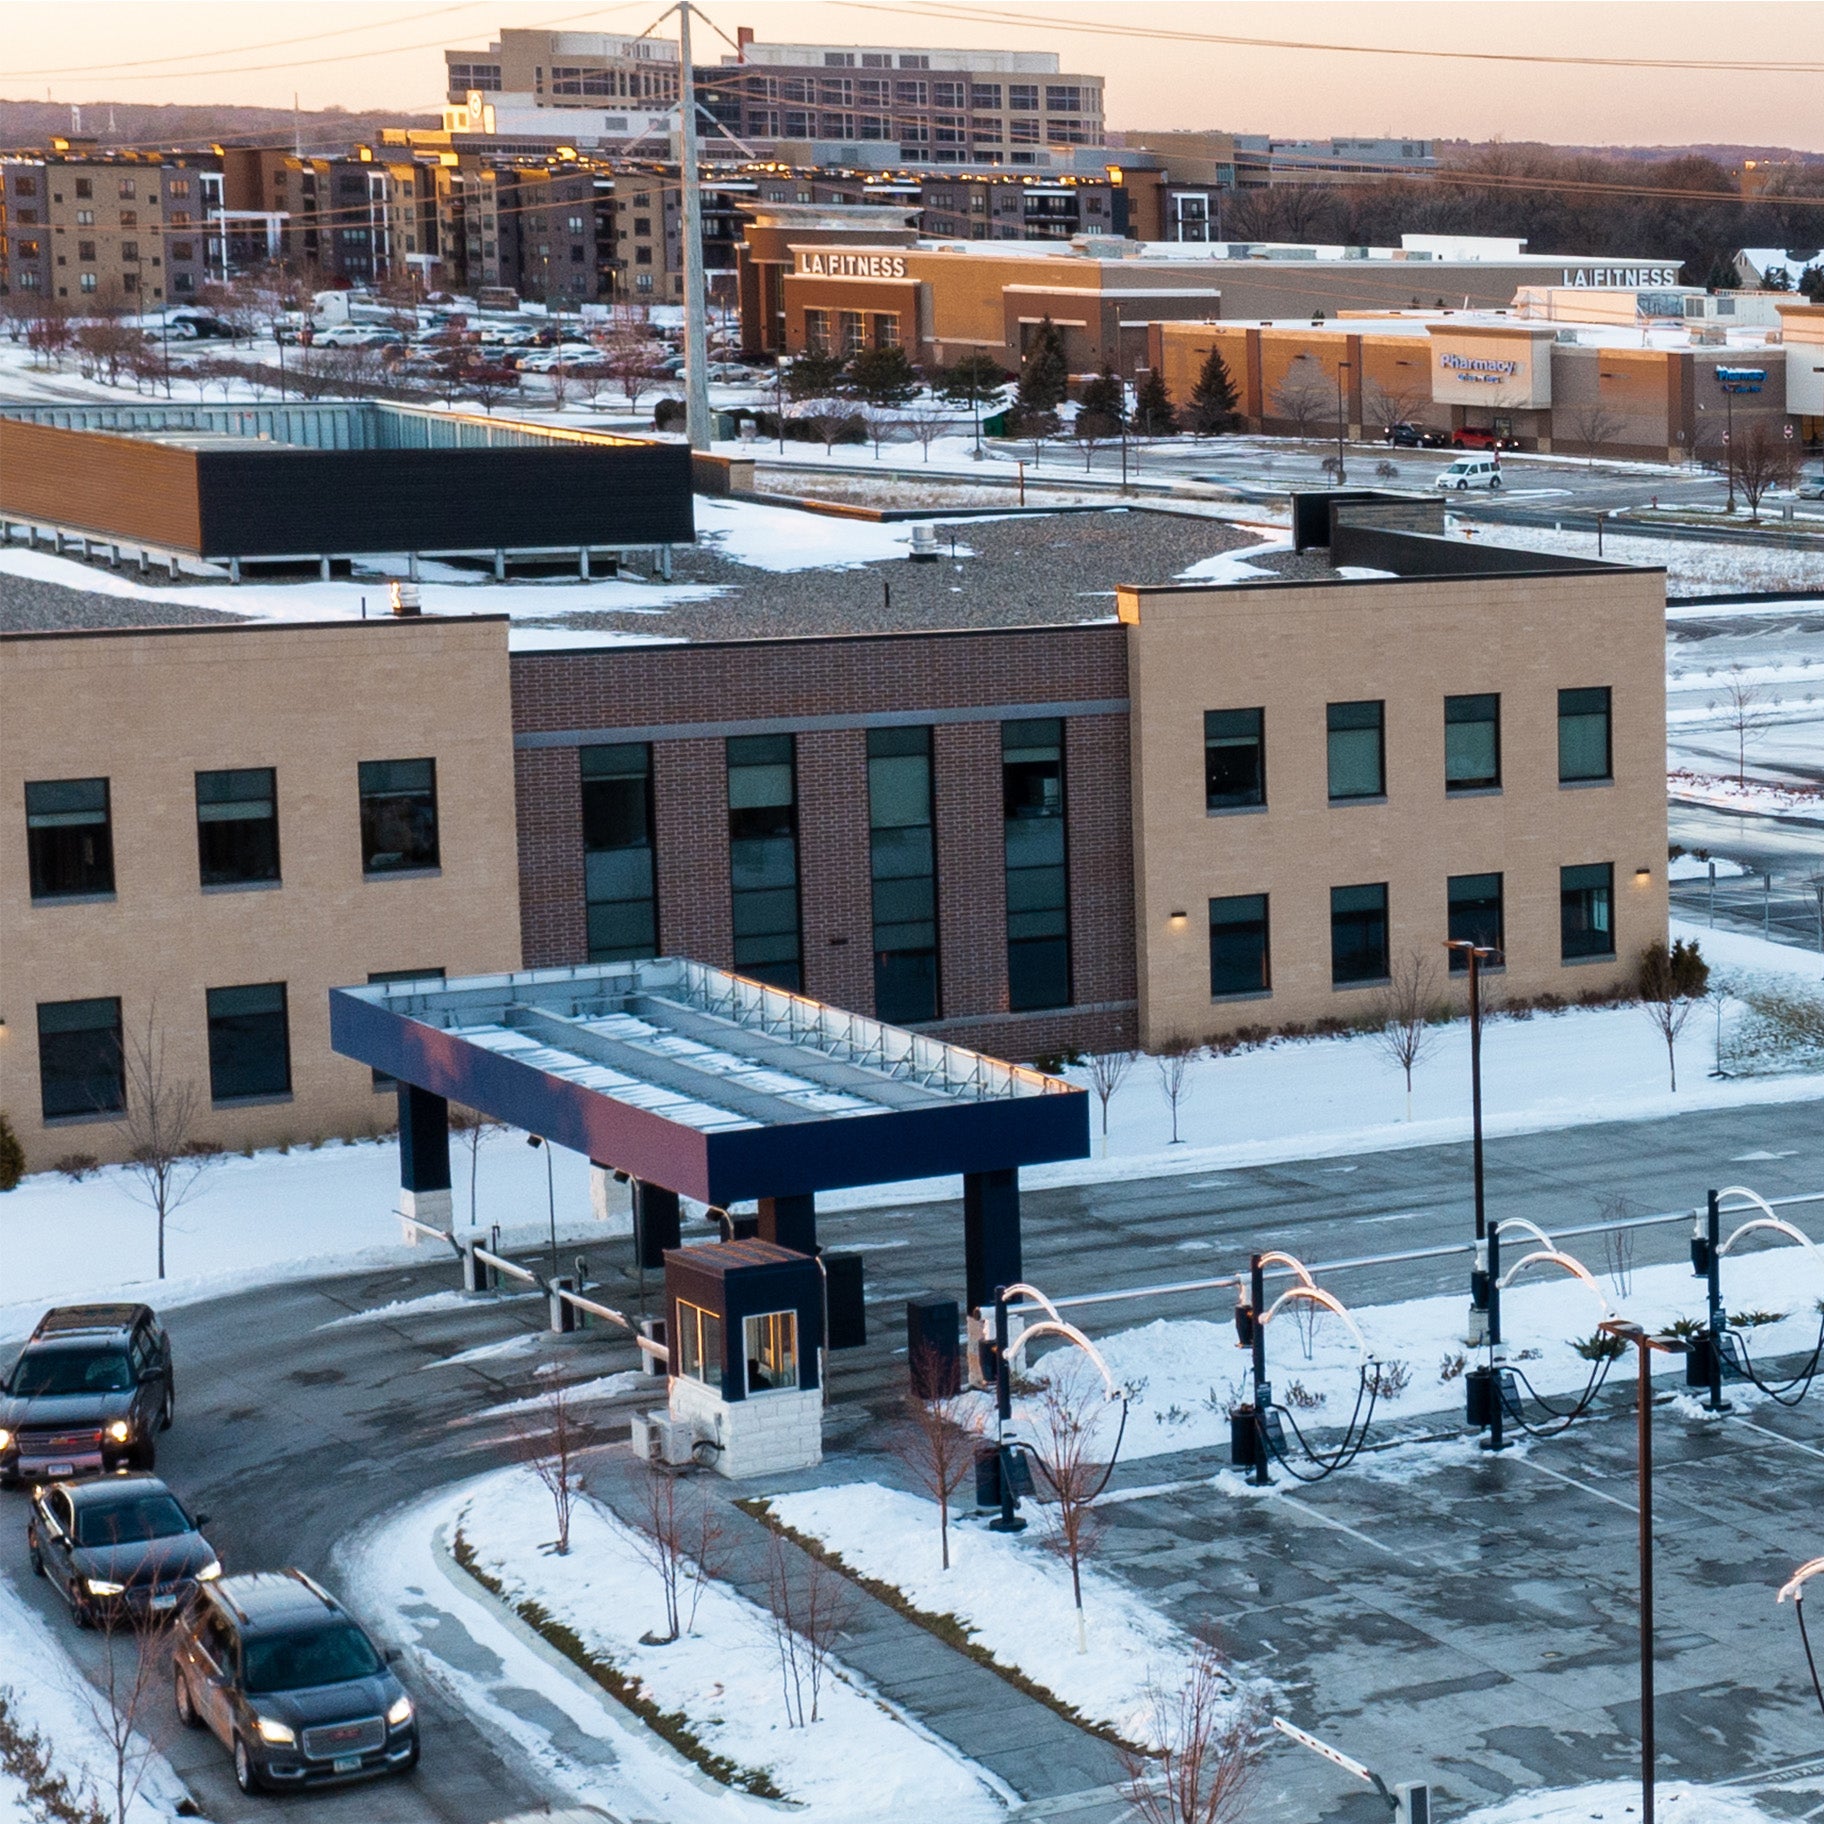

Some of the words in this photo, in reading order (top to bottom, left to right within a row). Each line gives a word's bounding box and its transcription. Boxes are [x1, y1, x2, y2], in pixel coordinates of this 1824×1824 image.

[828, 254, 905, 278] FITNESS
[1594, 268, 1675, 287] FITNESS
[1441, 353, 1514, 376] Pharmacy
